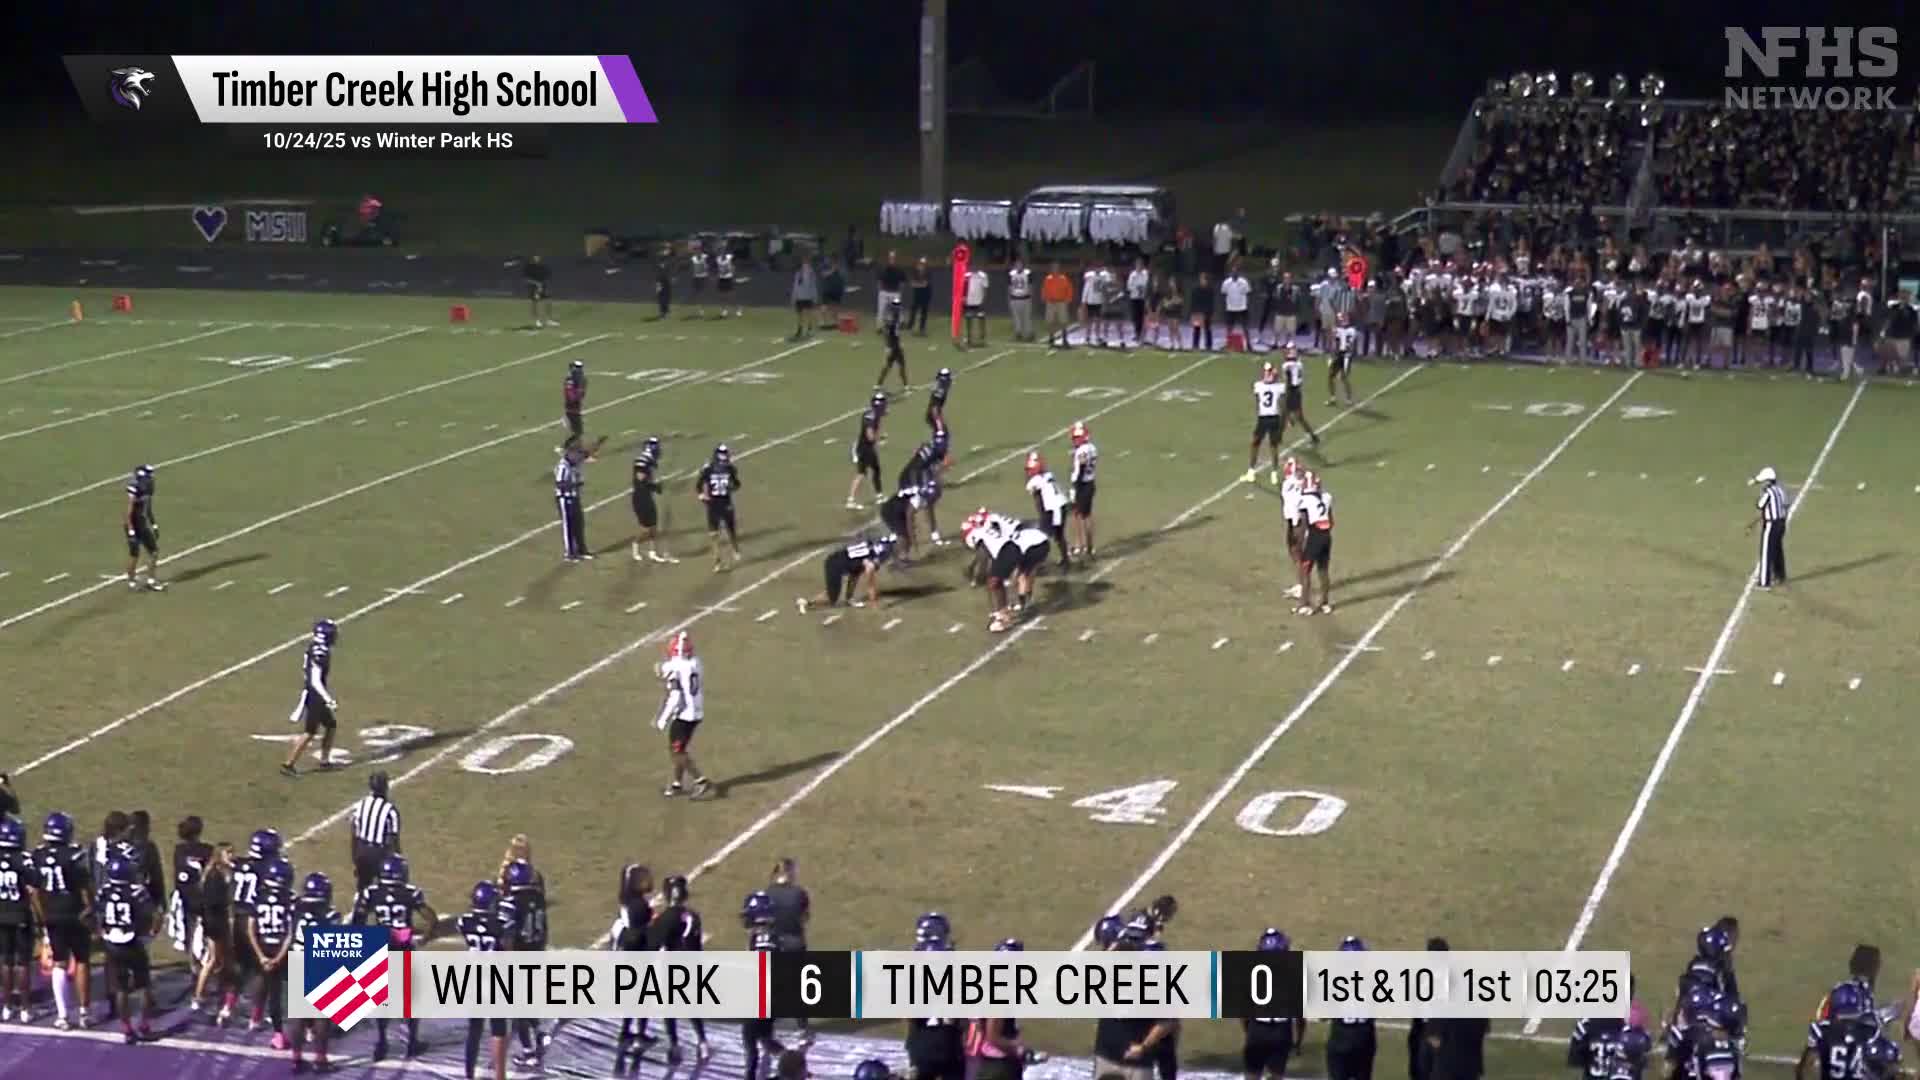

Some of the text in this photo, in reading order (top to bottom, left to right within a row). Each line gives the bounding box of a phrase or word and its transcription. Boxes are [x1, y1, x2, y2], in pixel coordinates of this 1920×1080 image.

[1262, 391, 1274, 408] 3
[1071, 779, 1347, 837] 40
[40, 866, 66, 892] 71
